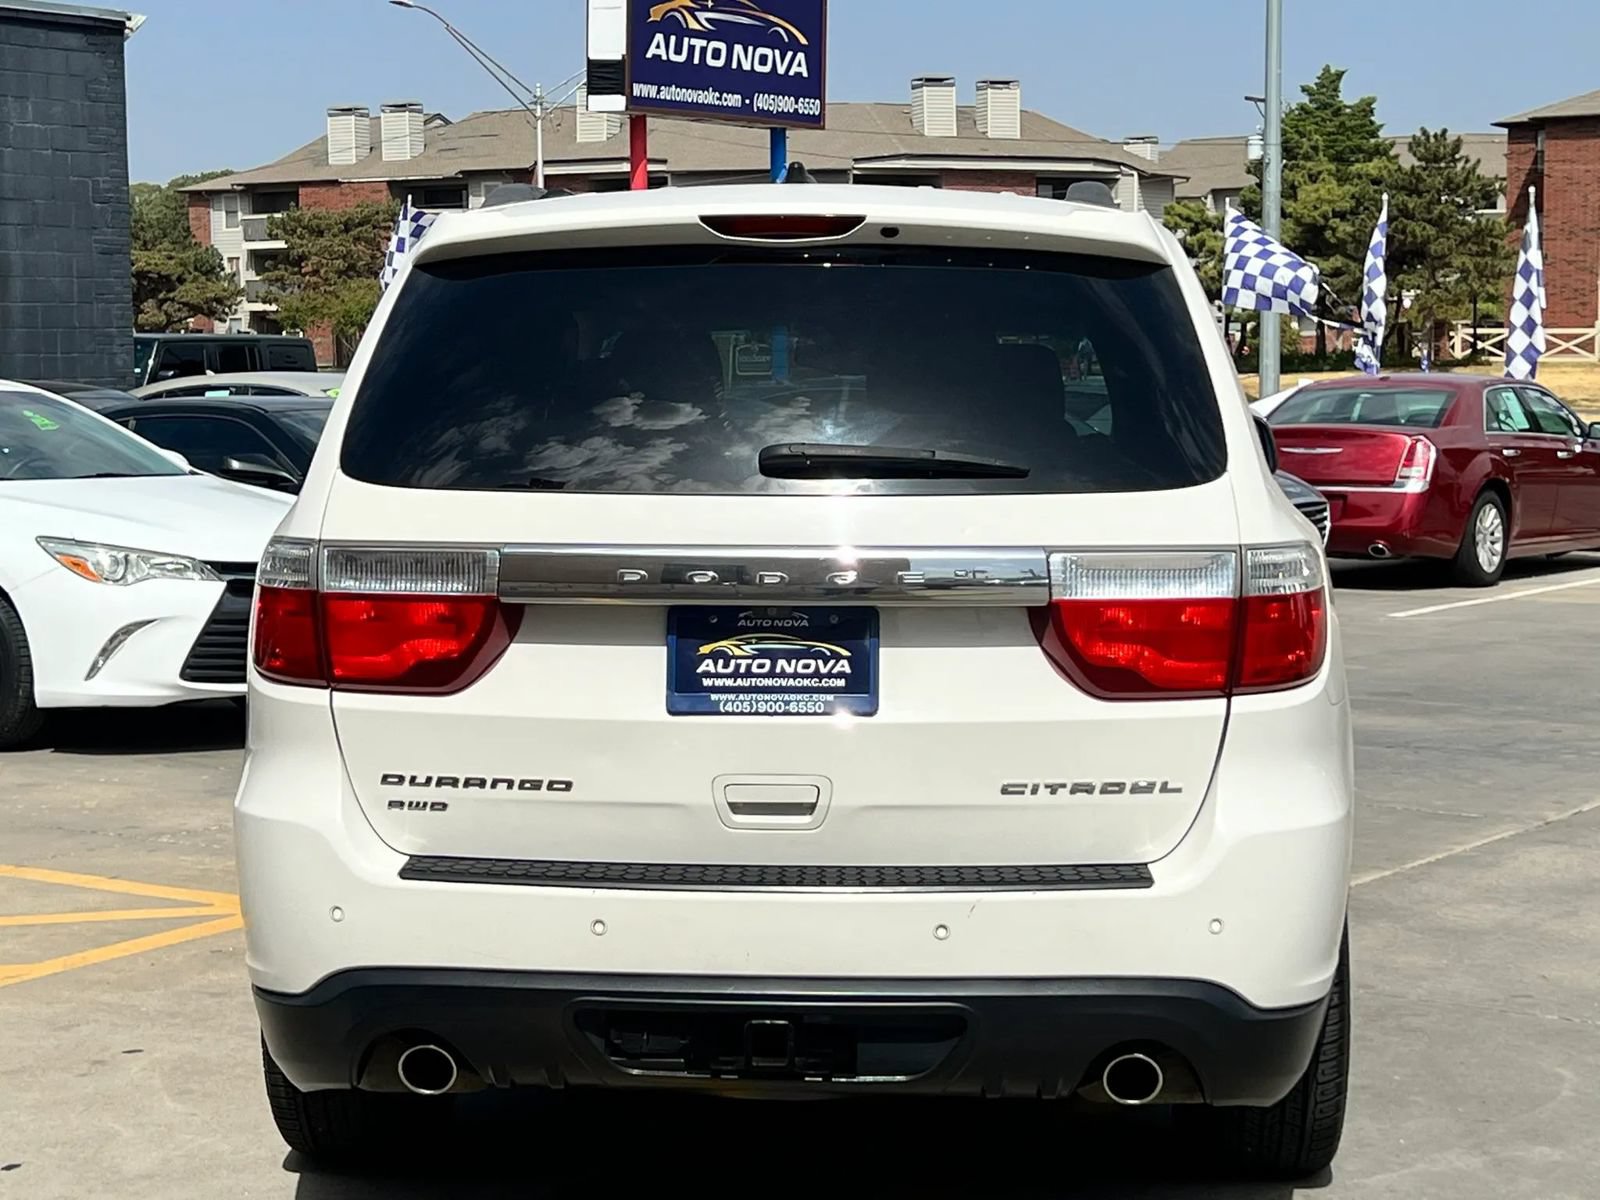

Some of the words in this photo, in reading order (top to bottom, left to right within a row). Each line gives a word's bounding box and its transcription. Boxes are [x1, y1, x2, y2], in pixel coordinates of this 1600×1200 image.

[645, 32, 726, 68] AUTO
[731, 43, 809, 78] NOVA
[632, 82, 742, 109] www.autonovaokc.com
[753, 92, 821, 116] (405)900-6550
[616, 568, 926, 586] DODGE
[737, 619, 772, 627] AUTO
[774, 619, 809, 627] NOVA
[696, 658, 771, 674] AUTO
[775, 658, 852, 674] NOVA
[702, 677, 846, 687] WWW.AUTONOVAOKC.COM
[710, 693, 835, 702] WWW.AUTONOVAOKC.COM
[719, 701, 825, 713] (405)900-6550
[380, 773, 574, 792] DURANGO
[1000, 780, 1183, 796] CITADEL
[387, 800, 449, 812] AWD
